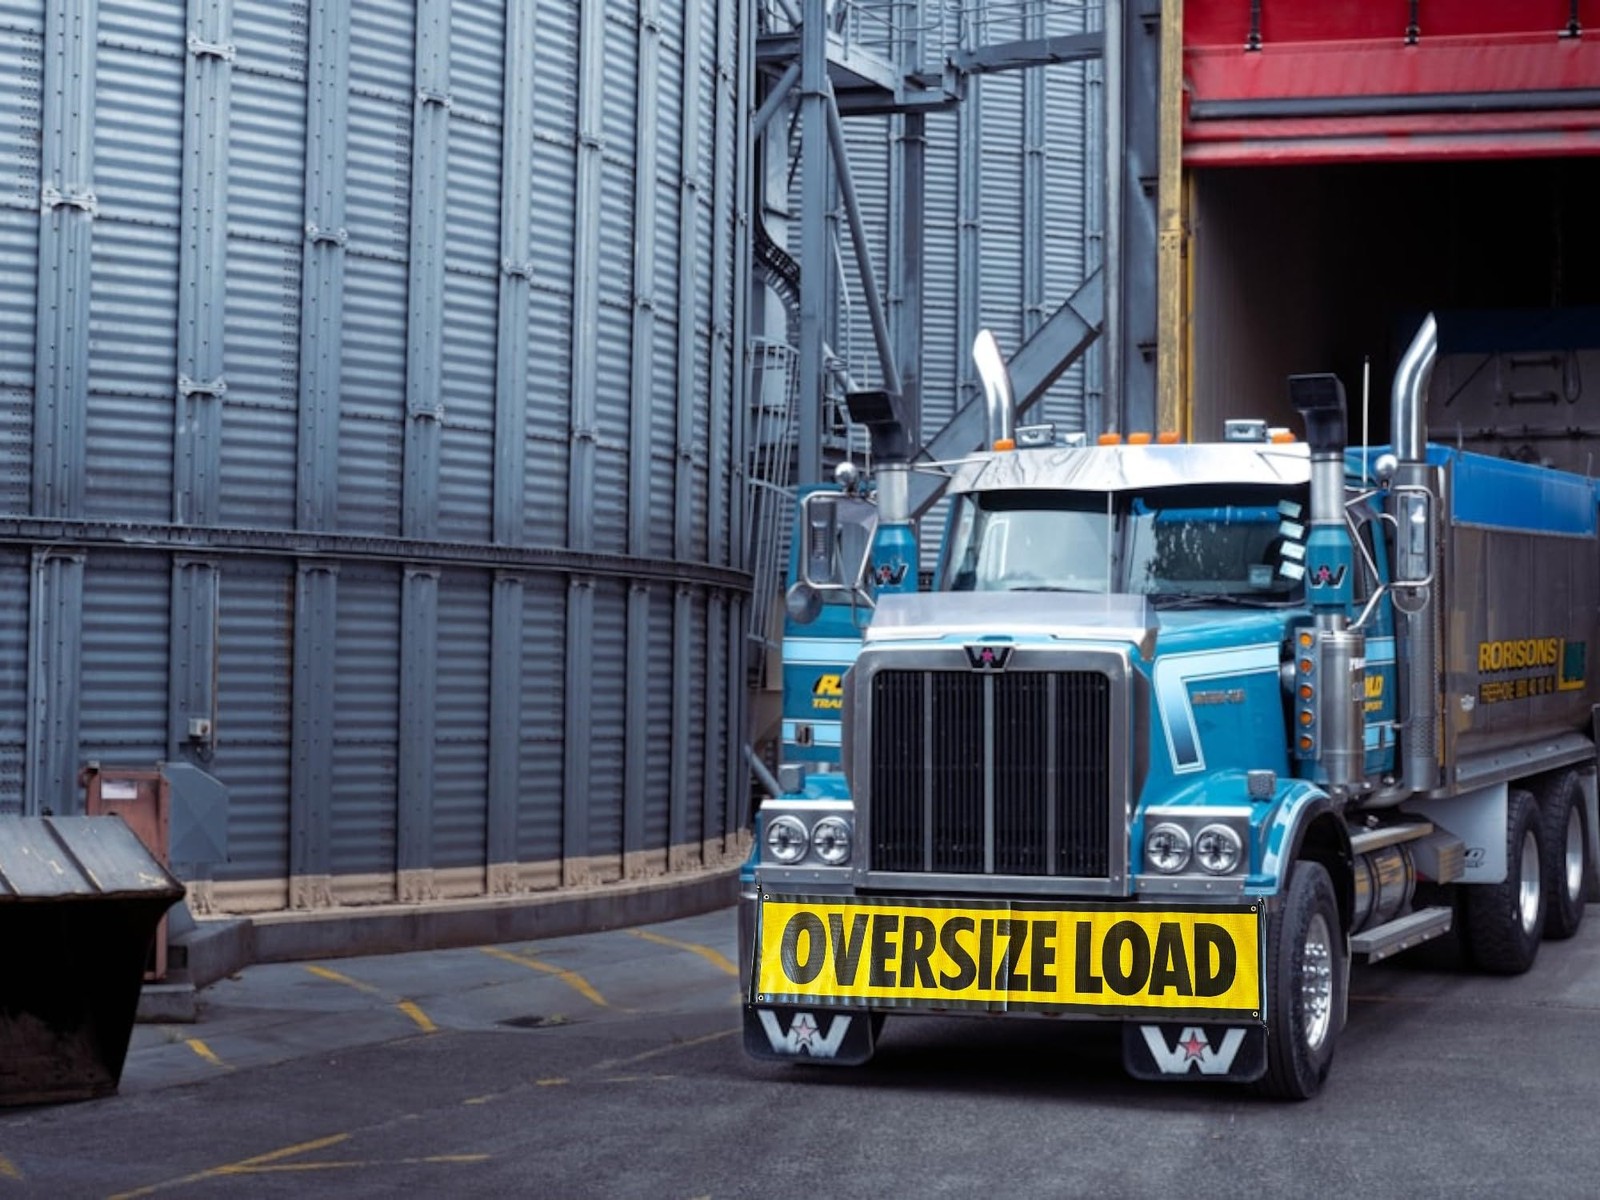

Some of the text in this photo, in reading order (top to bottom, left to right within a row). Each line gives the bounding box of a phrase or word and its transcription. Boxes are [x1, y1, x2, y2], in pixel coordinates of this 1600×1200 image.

[1478, 637, 1558, 673] RORISONS
[780, 911, 1237, 998] OVERSIZE LOAD
